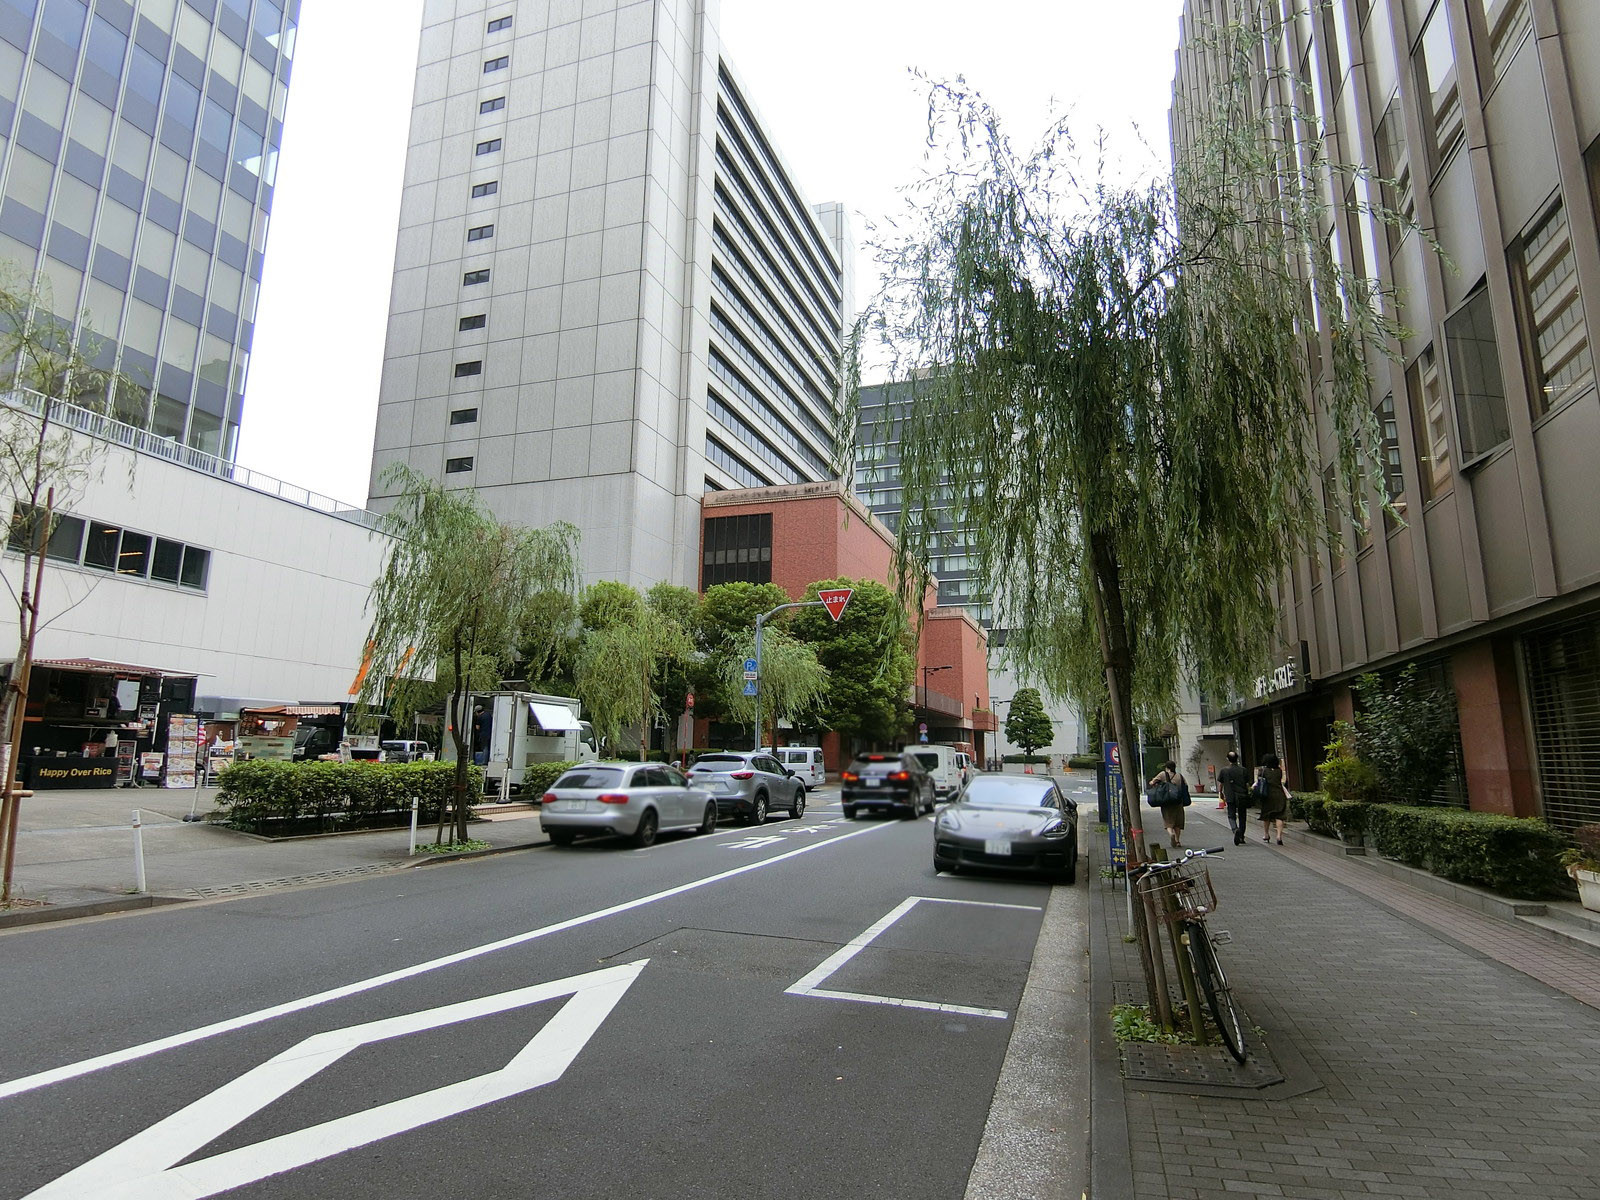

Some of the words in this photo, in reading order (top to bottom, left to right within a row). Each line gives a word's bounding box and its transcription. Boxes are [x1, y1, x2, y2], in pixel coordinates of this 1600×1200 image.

[825, 595, 846, 604] 止まれ
[39, 767, 69, 778] Happy
[70, 767, 92, 777] Over
[93, 767, 112, 776] Rice
